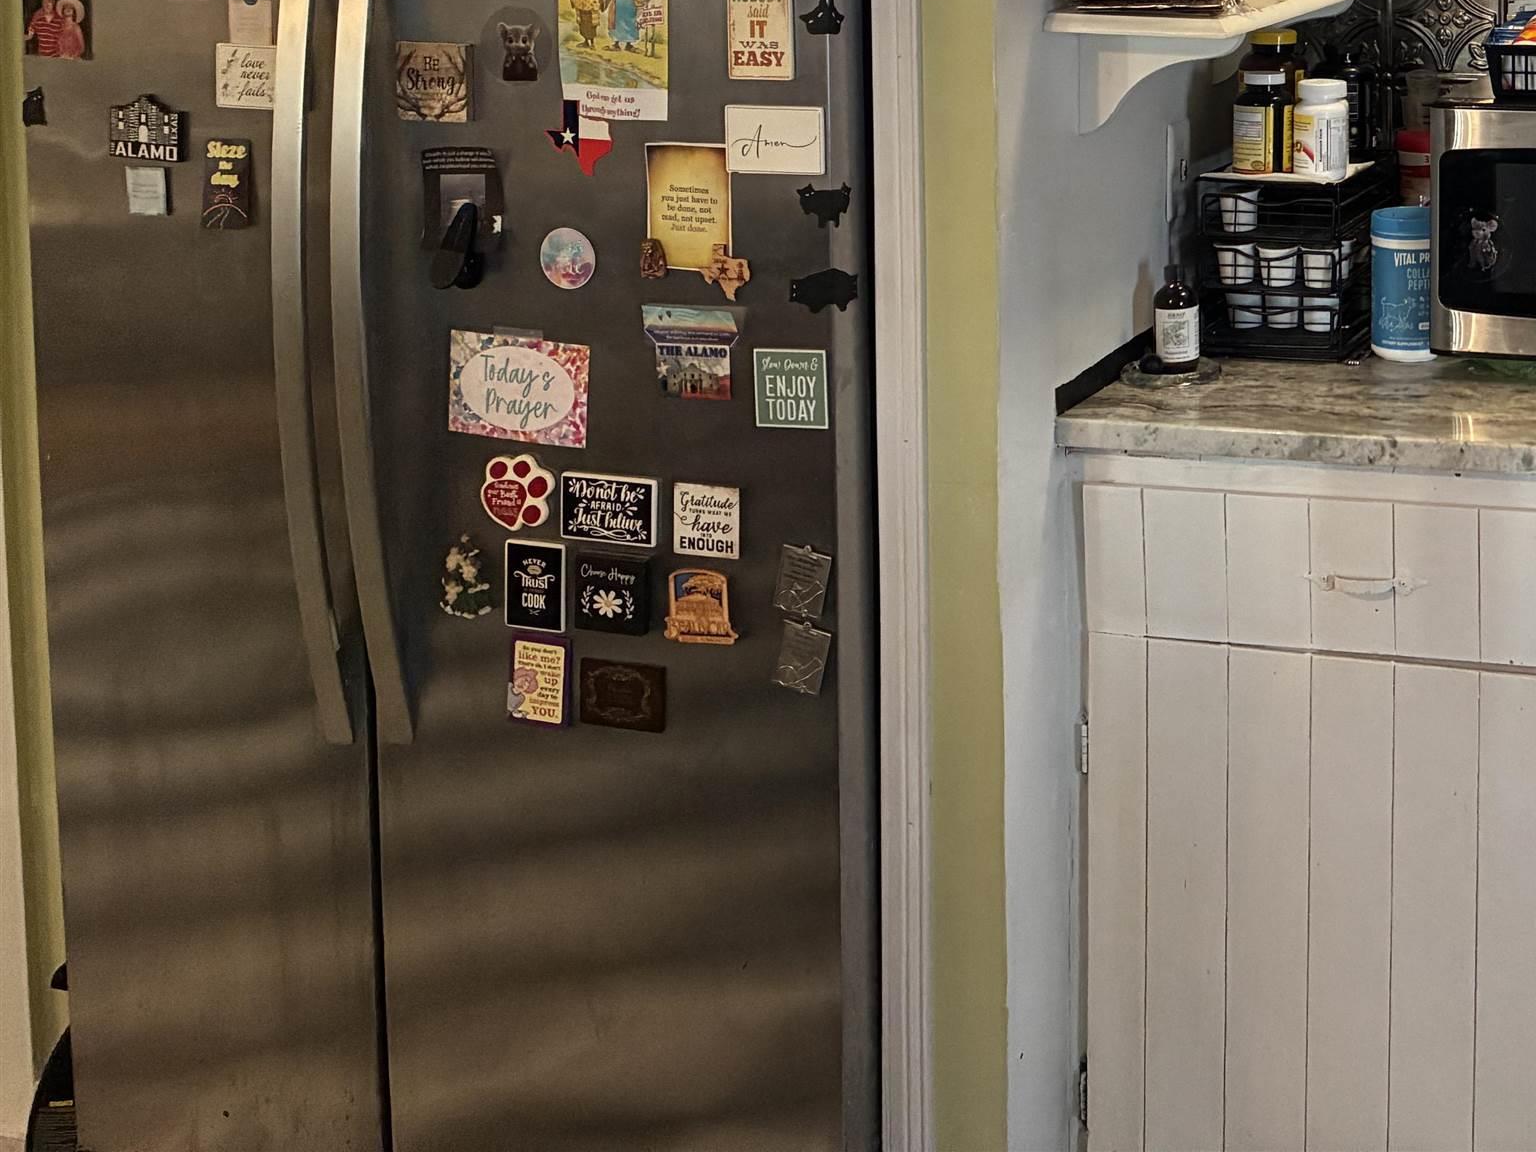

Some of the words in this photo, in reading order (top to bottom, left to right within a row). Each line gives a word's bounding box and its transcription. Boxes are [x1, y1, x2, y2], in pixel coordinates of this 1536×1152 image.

[747, 4, 770, 18] said
[749, 20, 767, 38] IT
[739, 40, 779, 50] WAS
[240, 52, 266, 69] love
[423, 56, 440, 72] BE
[733, 50, 785, 67] EASY
[240, 70, 271, 80] never
[406, 67, 455, 96] Strong
[170, 113, 179, 145] TEXAS
[732, 124, 818, 159] Amen
[115, 141, 178, 162] ALAMO
[669, 184, 710, 194] Sometimes
[661, 194, 675, 202] you
[675, 195, 690, 203] just
[691, 196, 709, 204] have
[710, 196, 719, 205] to
[667, 203, 676, 211] be
[677, 203, 697, 214] done,
[699, 206, 712, 214] not
[681, 214, 694, 222] not
[694, 216, 717, 225] upset.
[671, 223, 687, 232] Just
[687, 224, 708, 233] done.
[1394, 252, 1417, 268] VITAL
[1419, 252, 1430, 264] PR
[1408, 279, 1430, 291] PEPTI
[657, 346, 683, 357] THE
[685, 346, 727, 359] ALAMO
[783, 359, 809, 372] Down
[810, 357, 819, 371] &
[480, 354, 555, 398] Today's
[765, 374, 817, 399] ENJOY
[485, 388, 558, 429] Prayer
[765, 398, 817, 422] TODAY
[593, 482, 619, 502] not
[590, 500, 622, 512] AFRAID
[680, 490, 738, 512] Gratitude
[573, 508, 603, 528] Just
[689, 507, 706, 515] TURNS
[690, 514, 734, 535] have
[679, 535, 734, 554] ENOUGH
[522, 558, 547, 569] NEVER
[514, 570, 556, 590] TRUST
[608, 567, 636, 586] Happy
[521, 592, 547, 610] COOK
[518, 651, 538, 661] like
[540, 655, 561, 665] me?
[540, 686, 560, 694] every
[544, 677, 558, 687] up
[528, 698, 560, 708] impress
[537, 691, 550, 699] day
[531, 705, 559, 719] YOU.
